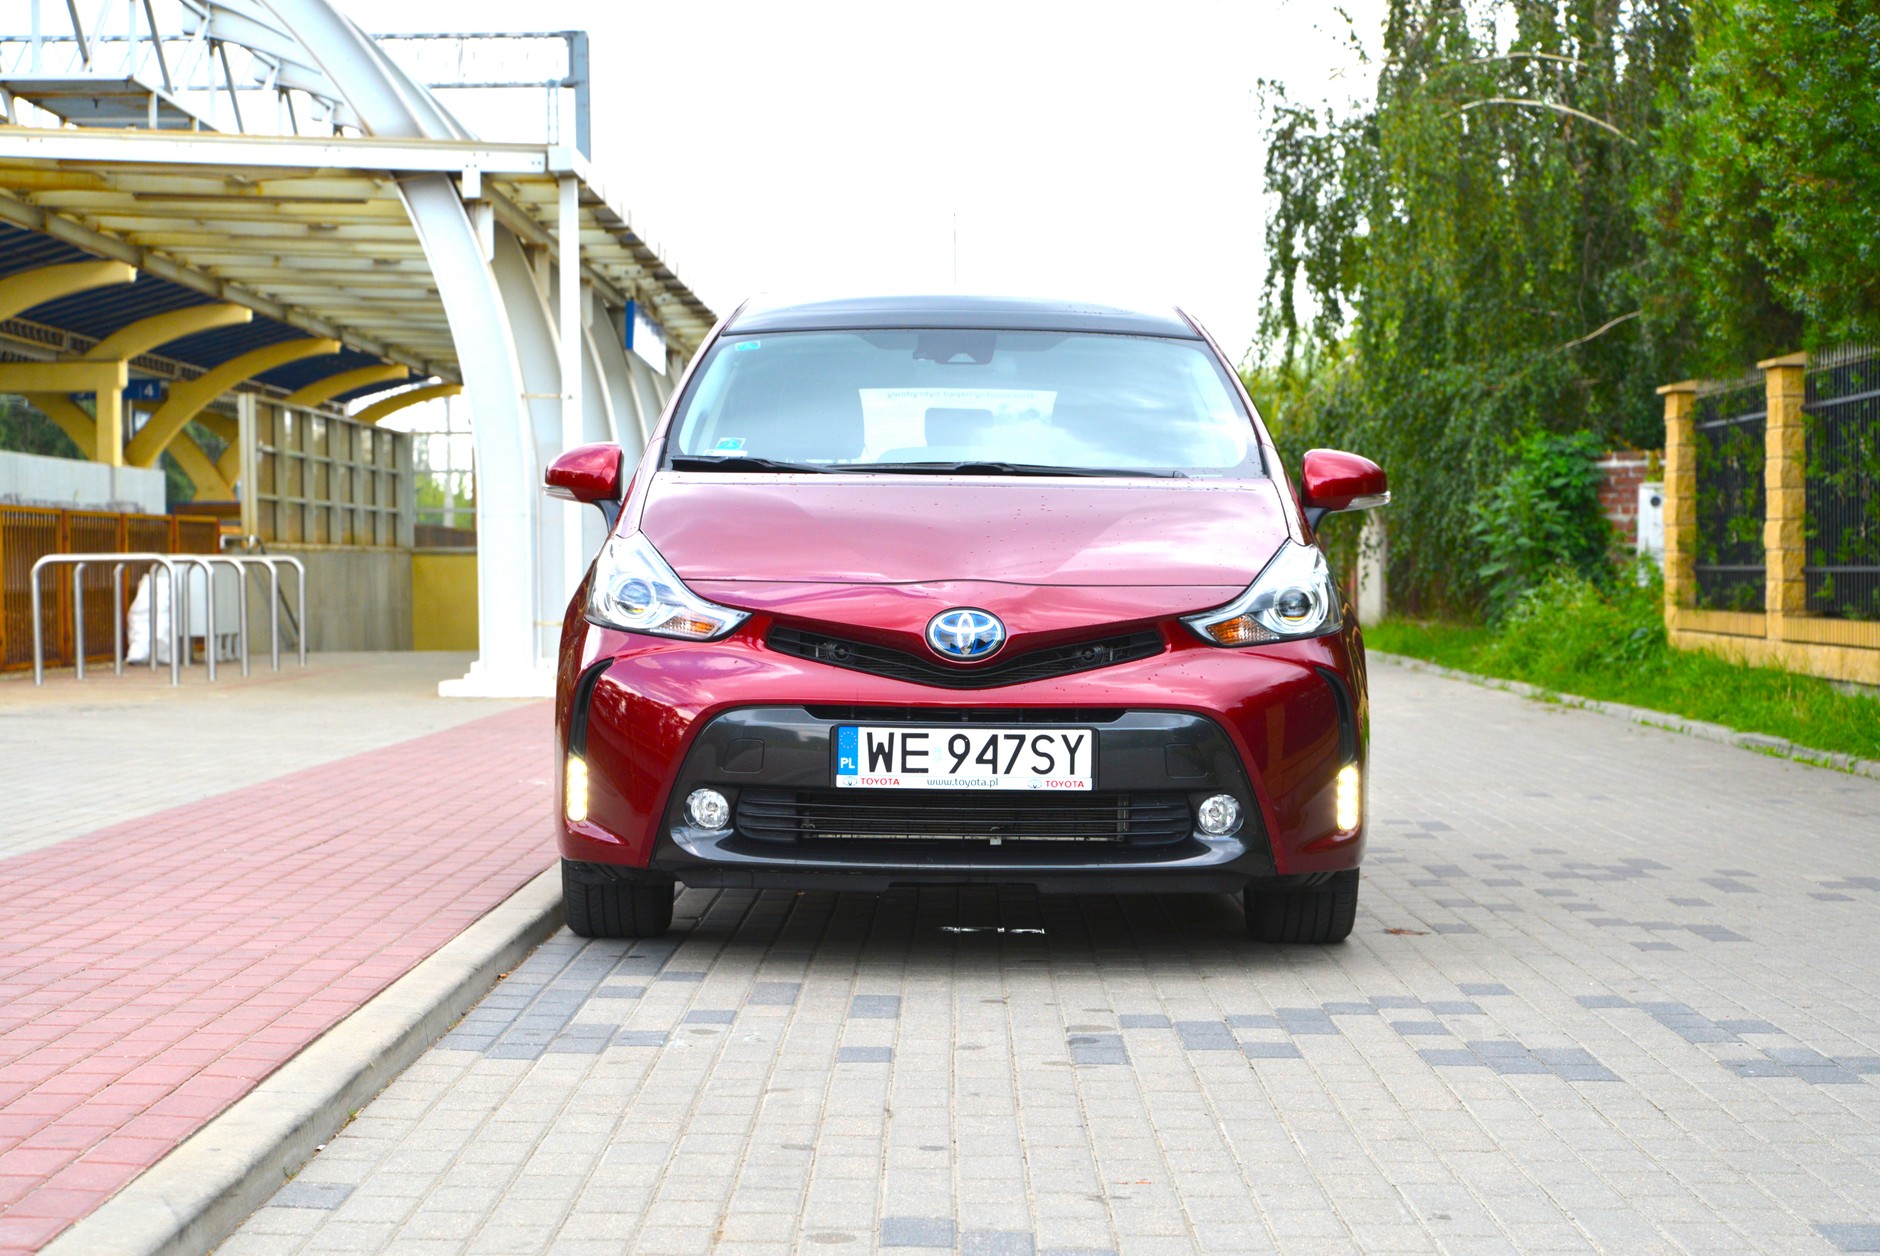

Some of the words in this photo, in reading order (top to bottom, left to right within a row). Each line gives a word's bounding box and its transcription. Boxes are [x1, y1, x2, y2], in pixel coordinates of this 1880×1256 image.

[867, 732, 930, 773] WE
[948, 733, 1085, 775] 947SY
[840, 757, 856, 769] PL
[860, 777, 900, 786] TOYOTA
[927, 777, 999, 788] www.toyota.pl
[1045, 780, 1085, 788] TOYOTA
